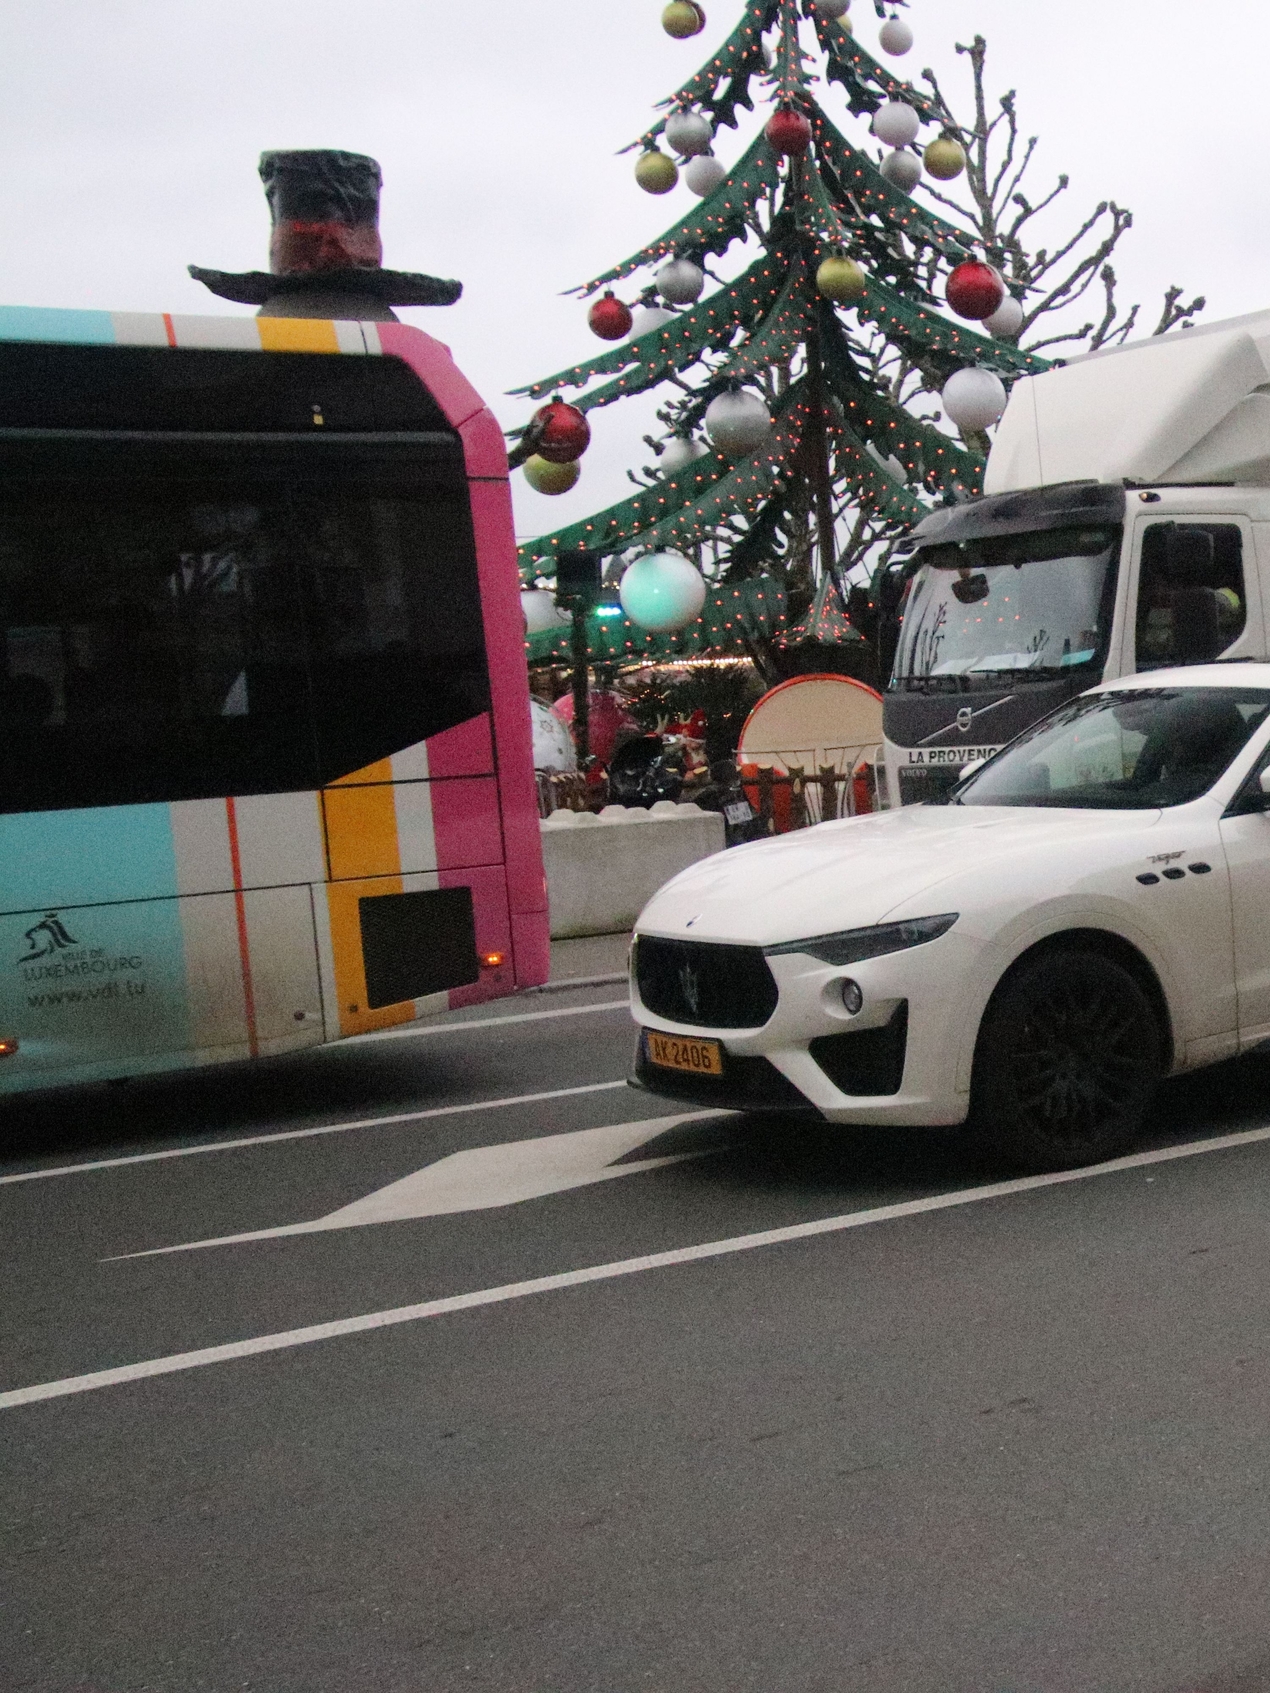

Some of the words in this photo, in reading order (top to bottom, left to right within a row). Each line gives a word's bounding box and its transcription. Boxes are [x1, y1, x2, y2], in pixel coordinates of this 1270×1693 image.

[909, 751, 925, 764] LA
[24, 955, 143, 982] LUXEMBOURG
[654, 1038, 670, 1062] AK
[671, 1041, 711, 1069] 2406
